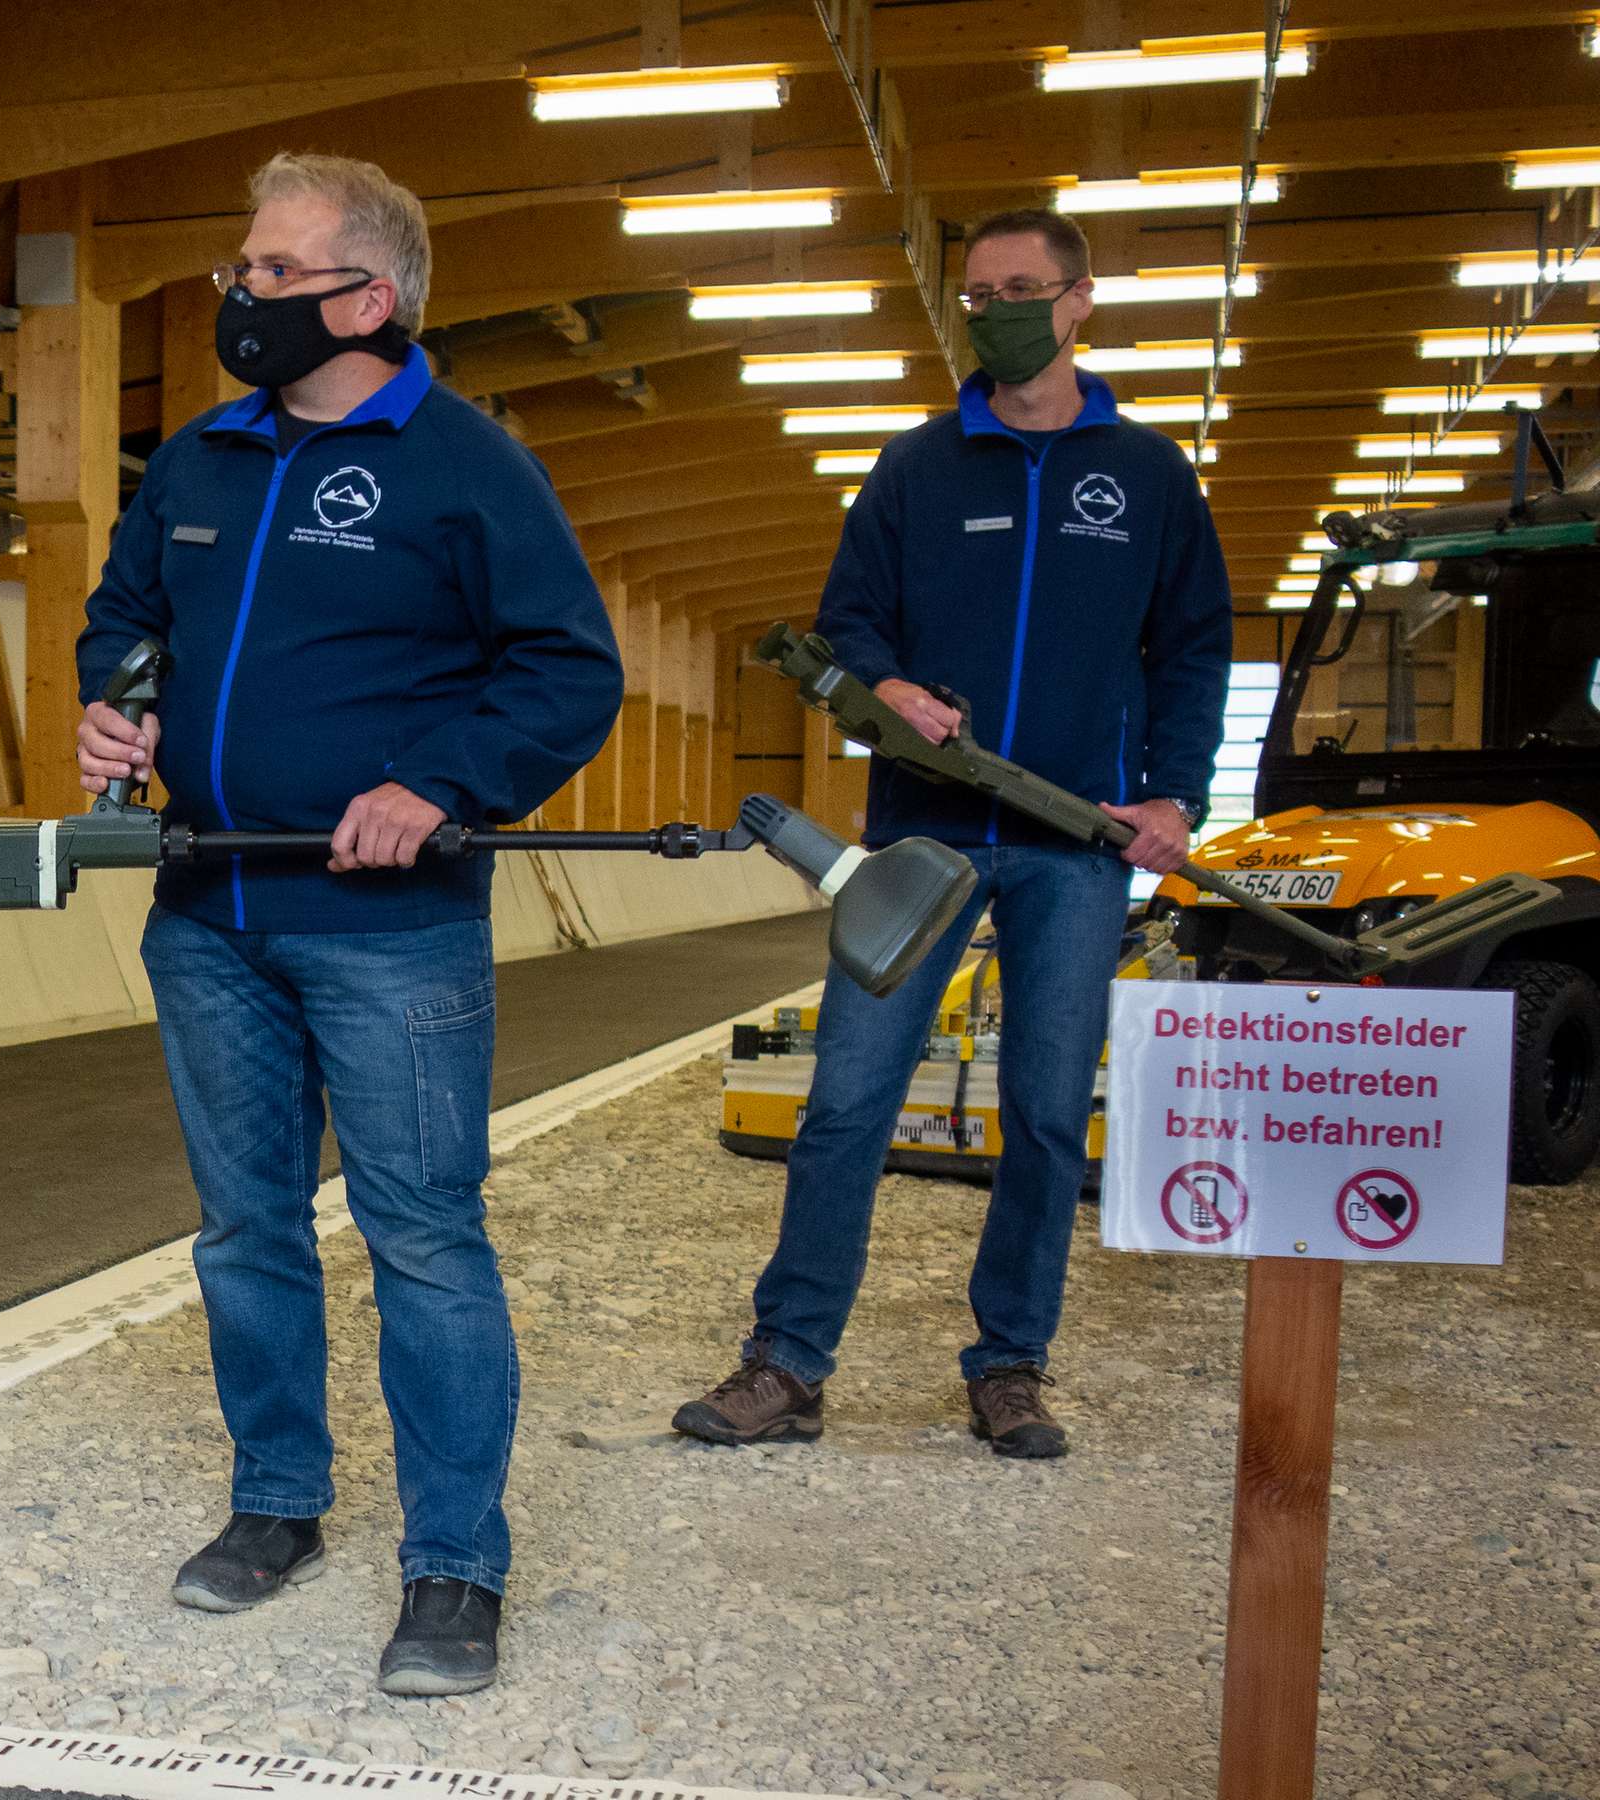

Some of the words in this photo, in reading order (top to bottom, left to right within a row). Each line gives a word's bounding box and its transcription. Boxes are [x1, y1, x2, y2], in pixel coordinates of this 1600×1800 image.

[1287, 875, 1335, 900] 060
[1154, 1008, 1468, 1049] Detektionsfelder
[1175, 1061, 1270, 1092] nicht
[1282, 1063, 1439, 1098] betreten
[1165, 1108, 1250, 1141] bzw.
[1264, 1113, 1444, 1149] befahren!
